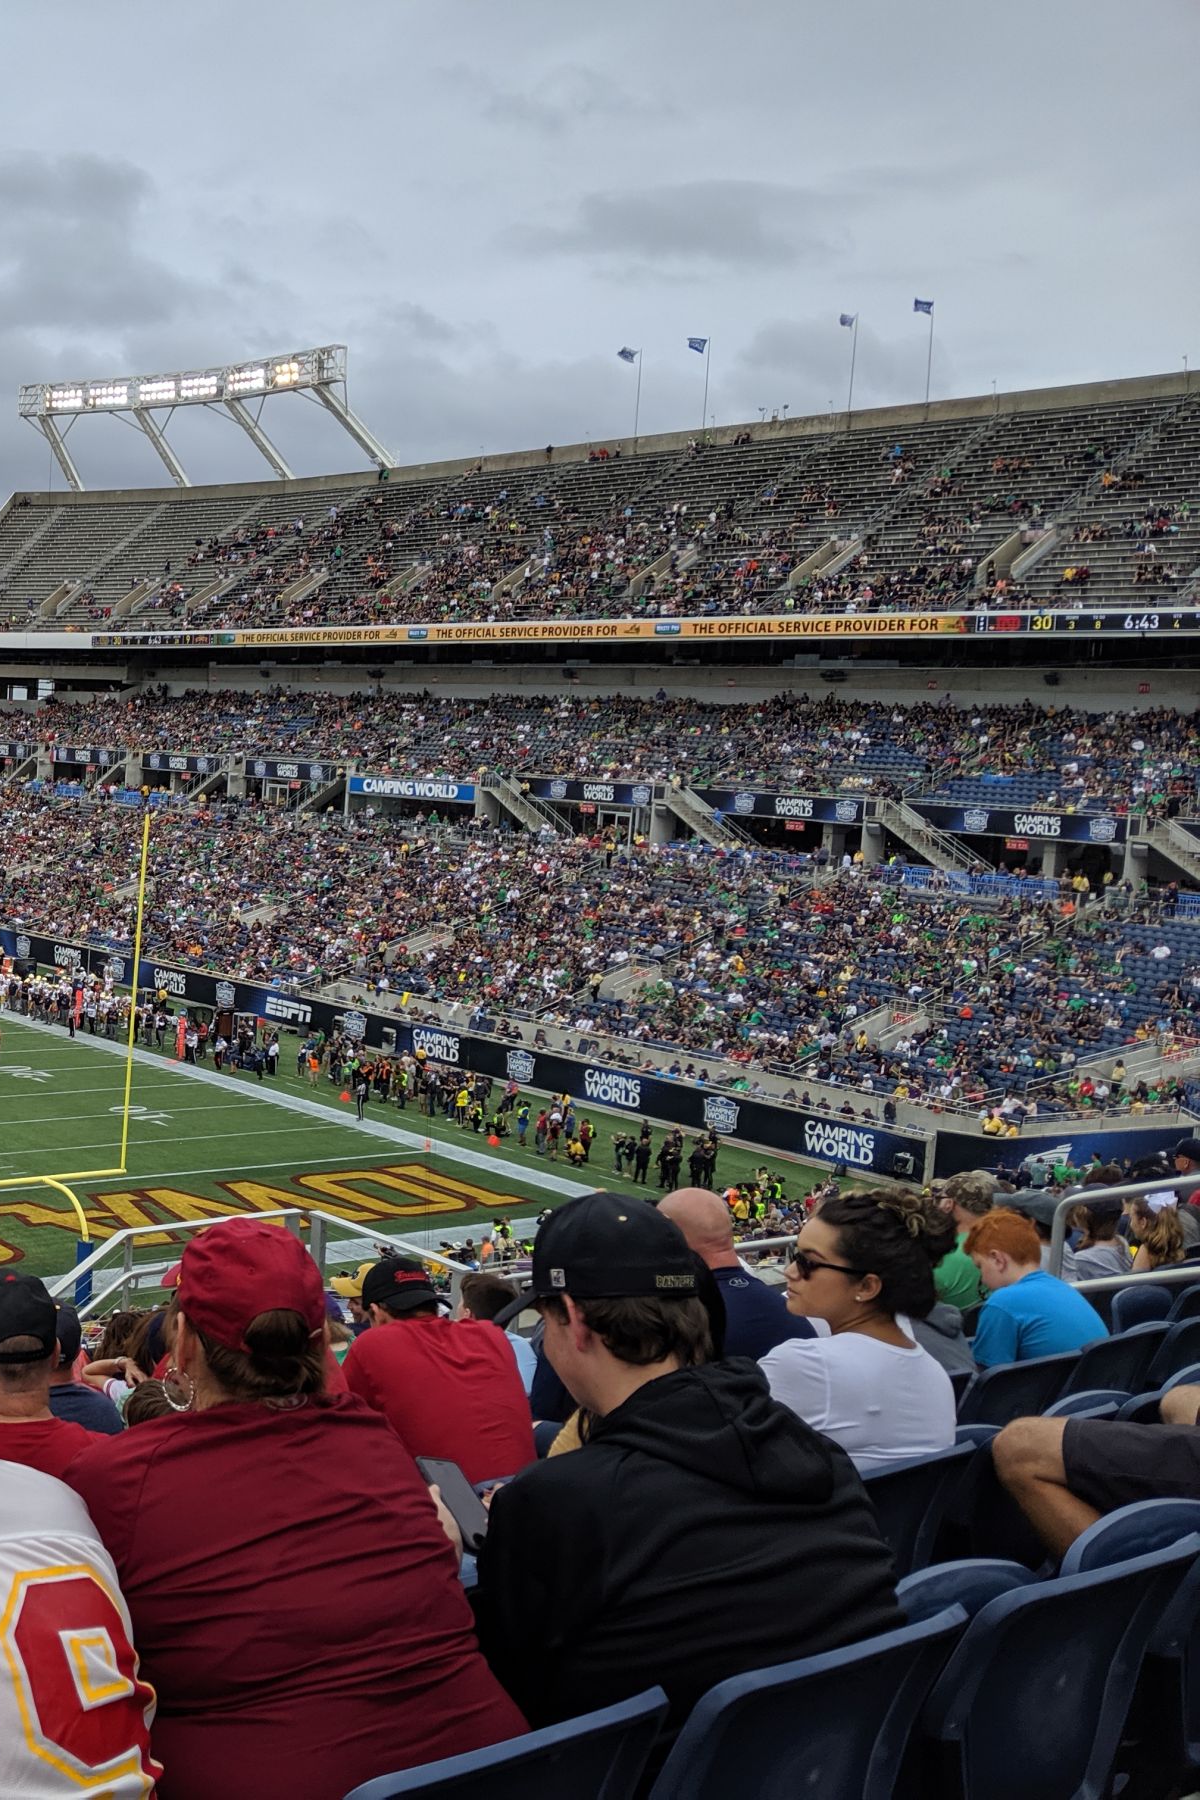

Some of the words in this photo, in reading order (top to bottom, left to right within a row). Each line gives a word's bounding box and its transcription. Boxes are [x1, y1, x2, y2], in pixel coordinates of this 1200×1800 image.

[692, 623, 714, 634] THE
[718, 622, 773, 634] OFFICIAL
[778, 620, 830, 633] SERVICE
[835, 619, 904, 632] PROVIDER
[909, 619, 938, 631] FOR
[1030, 616, 1050, 630] 30
[1066, 620, 1073, 629] 3
[1092, 620, 1099, 629] 8
[1121, 615, 1157, 629] 6:43
[1171, 620, 1178, 628] 4
[242, 633, 255, 642] THE
[256, 633, 290, 642] OFFICIAL
[291, 632, 321, 641] SERVICE
[322, 631, 362, 641] PROVIDER
[364, 630, 380, 639] FOR
[436, 629, 452, 638] THE
[456, 627, 496, 638] OFFICIAL
[500, 627, 540, 637] SERVICE
[542, 626, 593, 637] PROVIDER
[596, 625, 617, 636] FOR
[169, 756, 188, 764] CAMPING
[169, 762, 188, 770] WORLD
[277, 763, 298, 771] CAMPING
[277, 769, 298, 778] WORLD
[363, 779, 413, 796] CAMPING
[414, 782, 458, 798] WORLD
[584, 783, 614, 793] CAMPING
[584, 790, 614, 801] WORLD
[775, 797, 814, 808] CAMPING
[775, 805, 813, 816] WORLD
[1014, 814, 1061, 826] CAMPING
[1014, 822, 1061, 836] WORLD
[54, 944, 81, 960] CAMPING
[154, 968, 186, 984] CAMPING
[154, 979, 185, 995] WORLD
[265, 996, 312, 1023] ESPN
[412, 1028, 460, 1049] CAMPING
[413, 1039, 459, 1063] WORLD
[508, 1056, 530, 1067] CAMPING
[509, 1062, 530, 1073] WORLD
[584, 1068, 641, 1091] CAMPING
[585, 1081, 640, 1108] WORLD
[706, 1104, 733, 1118] CAMPING
[707, 1110, 733, 1124] WORLD
[804, 1119, 875, 1149] CAMPING
[805, 1133, 873, 1166] WORLD
